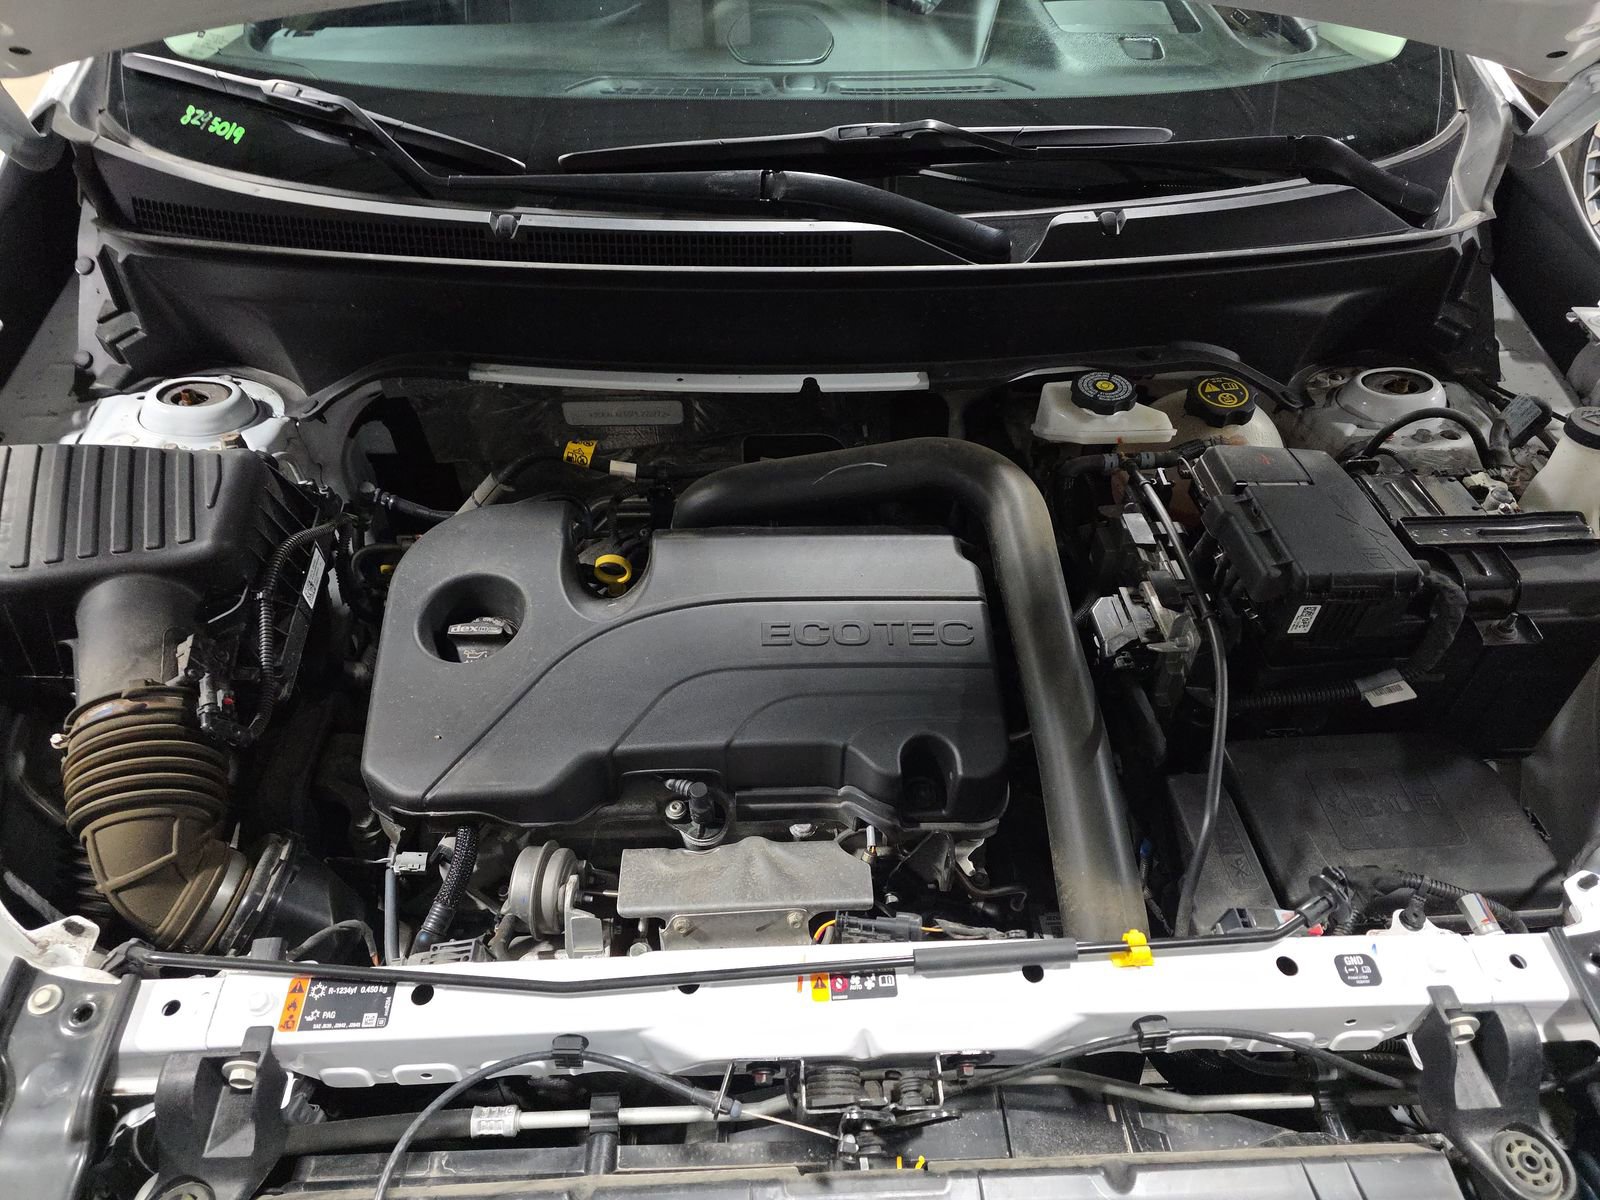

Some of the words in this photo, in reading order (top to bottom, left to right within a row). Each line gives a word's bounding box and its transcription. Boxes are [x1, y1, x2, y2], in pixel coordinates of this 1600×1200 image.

[761, 620, 975, 646] ECOTEC
[1344, 956, 1364, 966] GND
[379, 985, 388, 994] kg
[322, 1011, 336, 1019] PAG
